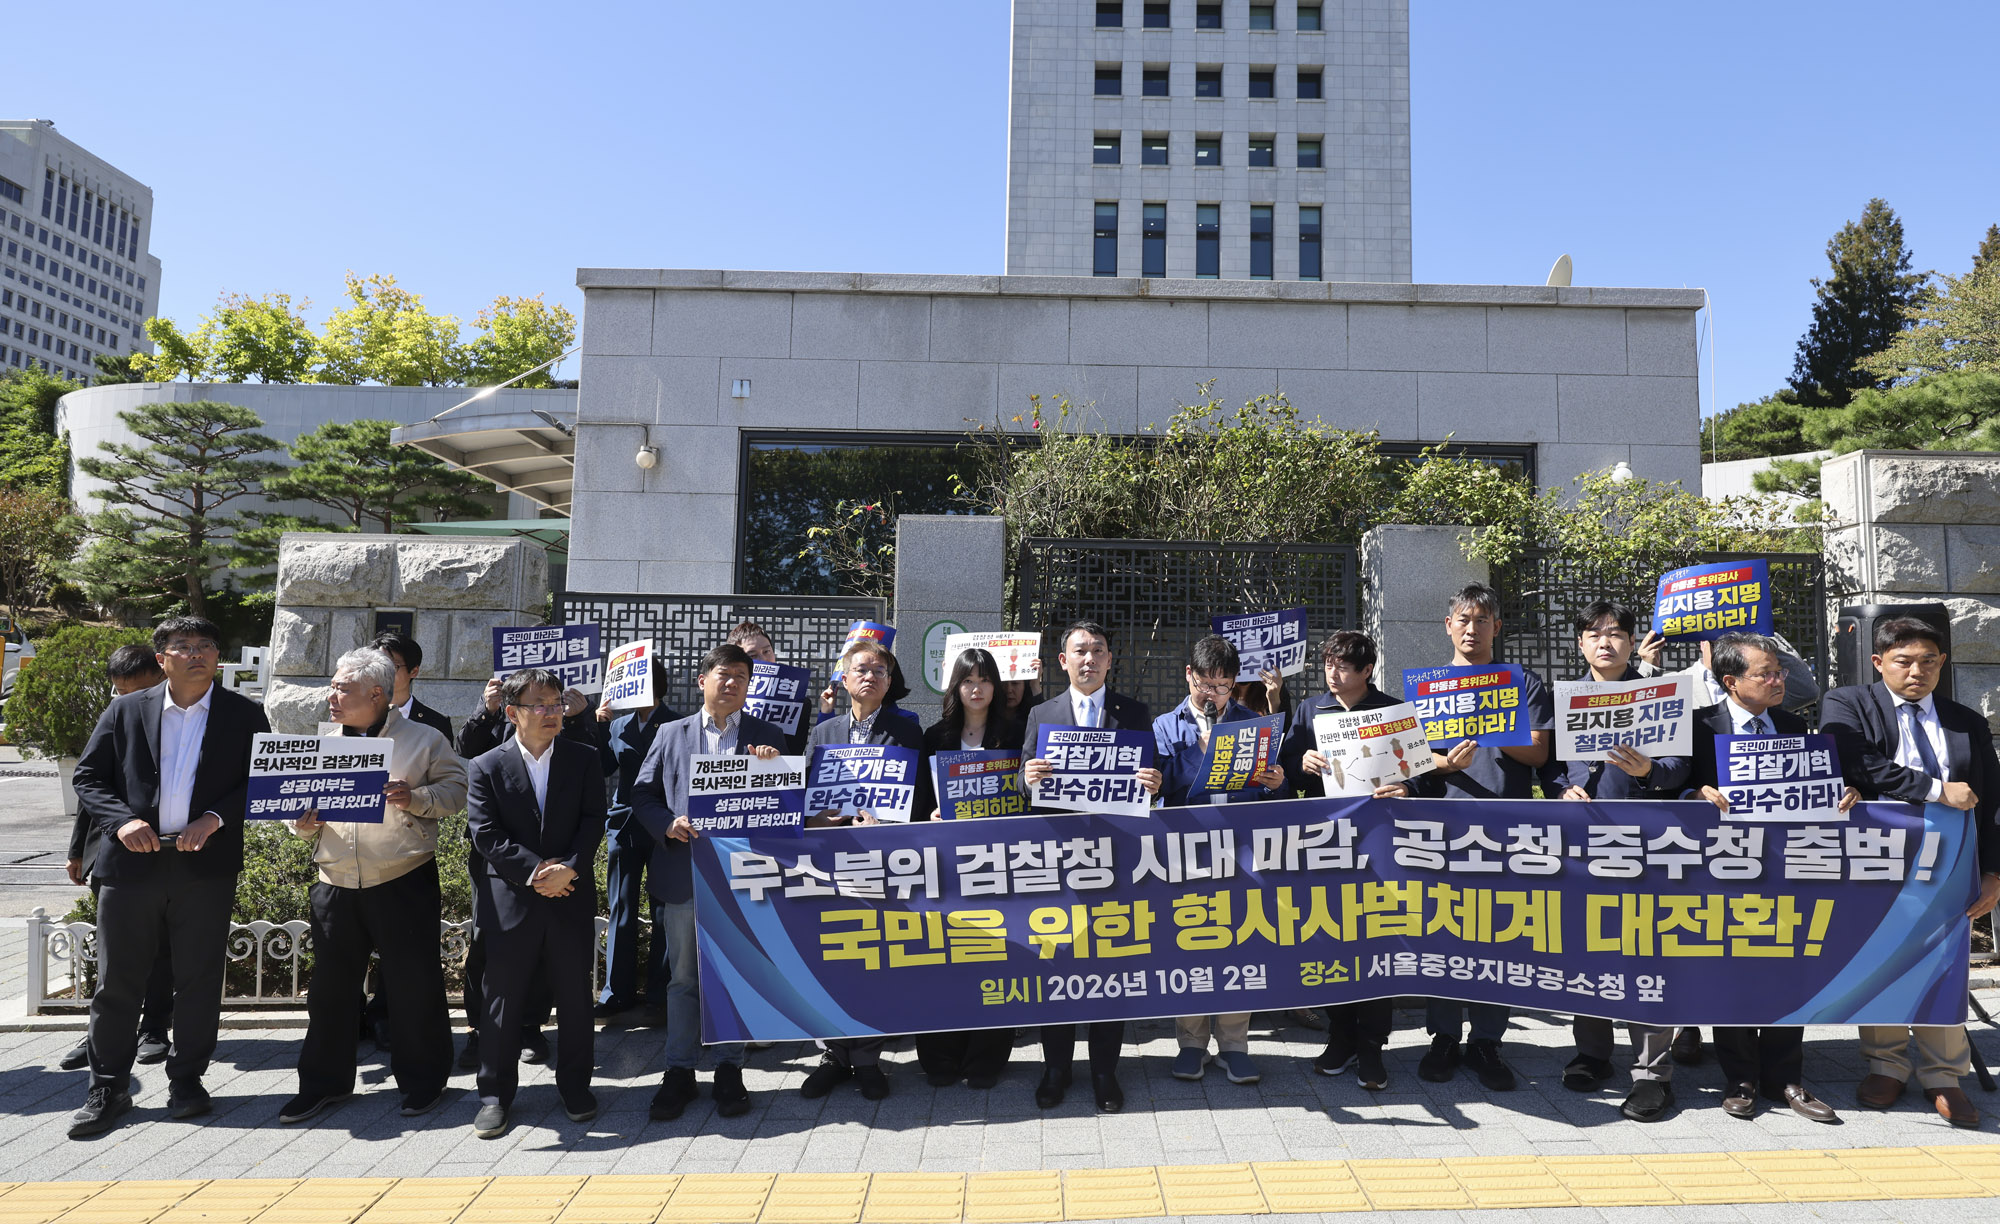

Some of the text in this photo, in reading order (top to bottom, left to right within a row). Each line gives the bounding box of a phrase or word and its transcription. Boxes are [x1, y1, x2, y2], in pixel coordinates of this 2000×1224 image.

[1671, 571, 1738, 593] 한동훈 호위검사
[1658, 582, 1761, 617] 김지용 지명
[1227, 616, 1275, 629] 국민이 바라는
[1661, 605, 1758, 636] 철회하라!
[507, 630, 559, 642] 국민이 바라는
[1223, 620, 1299, 650] 검찰개혁
[502, 637, 589, 667] 검찰개혁
[1238, 645, 1304, 677] 수하라!
[625, 658, 647, 677] 지명
[754, 664, 775, 674] 바라는
[747, 675, 799, 699] 찰개혁
[1429, 674, 1499, 693] 한동훈 호위검사
[1415, 687, 1519, 719] 김지용 지명
[1588, 688, 1658, 707] 친윤검사 출신
[744, 701, 799, 724] 하라!
[1338, 713, 1383, 728] 검찰청 폐지?
[1566, 698, 1684, 732] 김지용 지명
[1053, 732, 1111, 742] 국민이 바라는
[1320, 718, 1415, 744] 간판만 바뀐 2개의 검찰청!
[1424, 711, 1516, 741] 철회하라!
[1575, 722, 1677, 753] 철회하라!
[258, 740, 320, 754] 78년만의
[828, 748, 880, 759] 국민이 바라는
[1258, 736, 1269, 759] 한동훈
[1735, 739, 1801, 752] 국민이 바라는
[253, 754, 384, 772] 역사적인 검찰개혁
[696, 759, 748, 774] 78년만의
[960, 759, 1018, 774] 한동훈 호위검사
[1044, 745, 1142, 771] 검찰개혁
[1204, 734, 1236, 790] 철회하라!
[1225, 727, 1256, 790] 김지용 지명
[1728, 749, 1832, 782] 검찰개혁
[692, 772, 801, 791] 역사적인 검찰개혁
[818, 759, 907, 783] 검찰개혁
[280, 778, 355, 794] 성공여부는
[947, 773, 1018, 799] 김지용 지
[1039, 777, 1146, 803] 완수하라!
[250, 794, 381, 813] 정부에게 달려있다!
[715, 796, 779, 812] 성공여부는
[809, 787, 910, 811] 완수하라!
[955, 795, 1032, 819] 철회하라!
[1728, 783, 1842, 814] 완수하라!
[691, 812, 801, 830] 정부에게 달려있다!
[730, 847, 940, 900] 무소불위
[956, 837, 1114, 896] 검찰청
[1132, 829, 1235, 884] 시대
[1252, 818, 1369, 872] 마감,
[1784, 826, 1940, 881] 출범!
[820, 880, 1835, 970] 국민을 위한 형사사법체계 대전환!
[980, 964, 1267, 1005] 일시 2026년 10월 2일
[1300, 952, 1665, 1002] 장소 서울중앙지방공소청 앞
